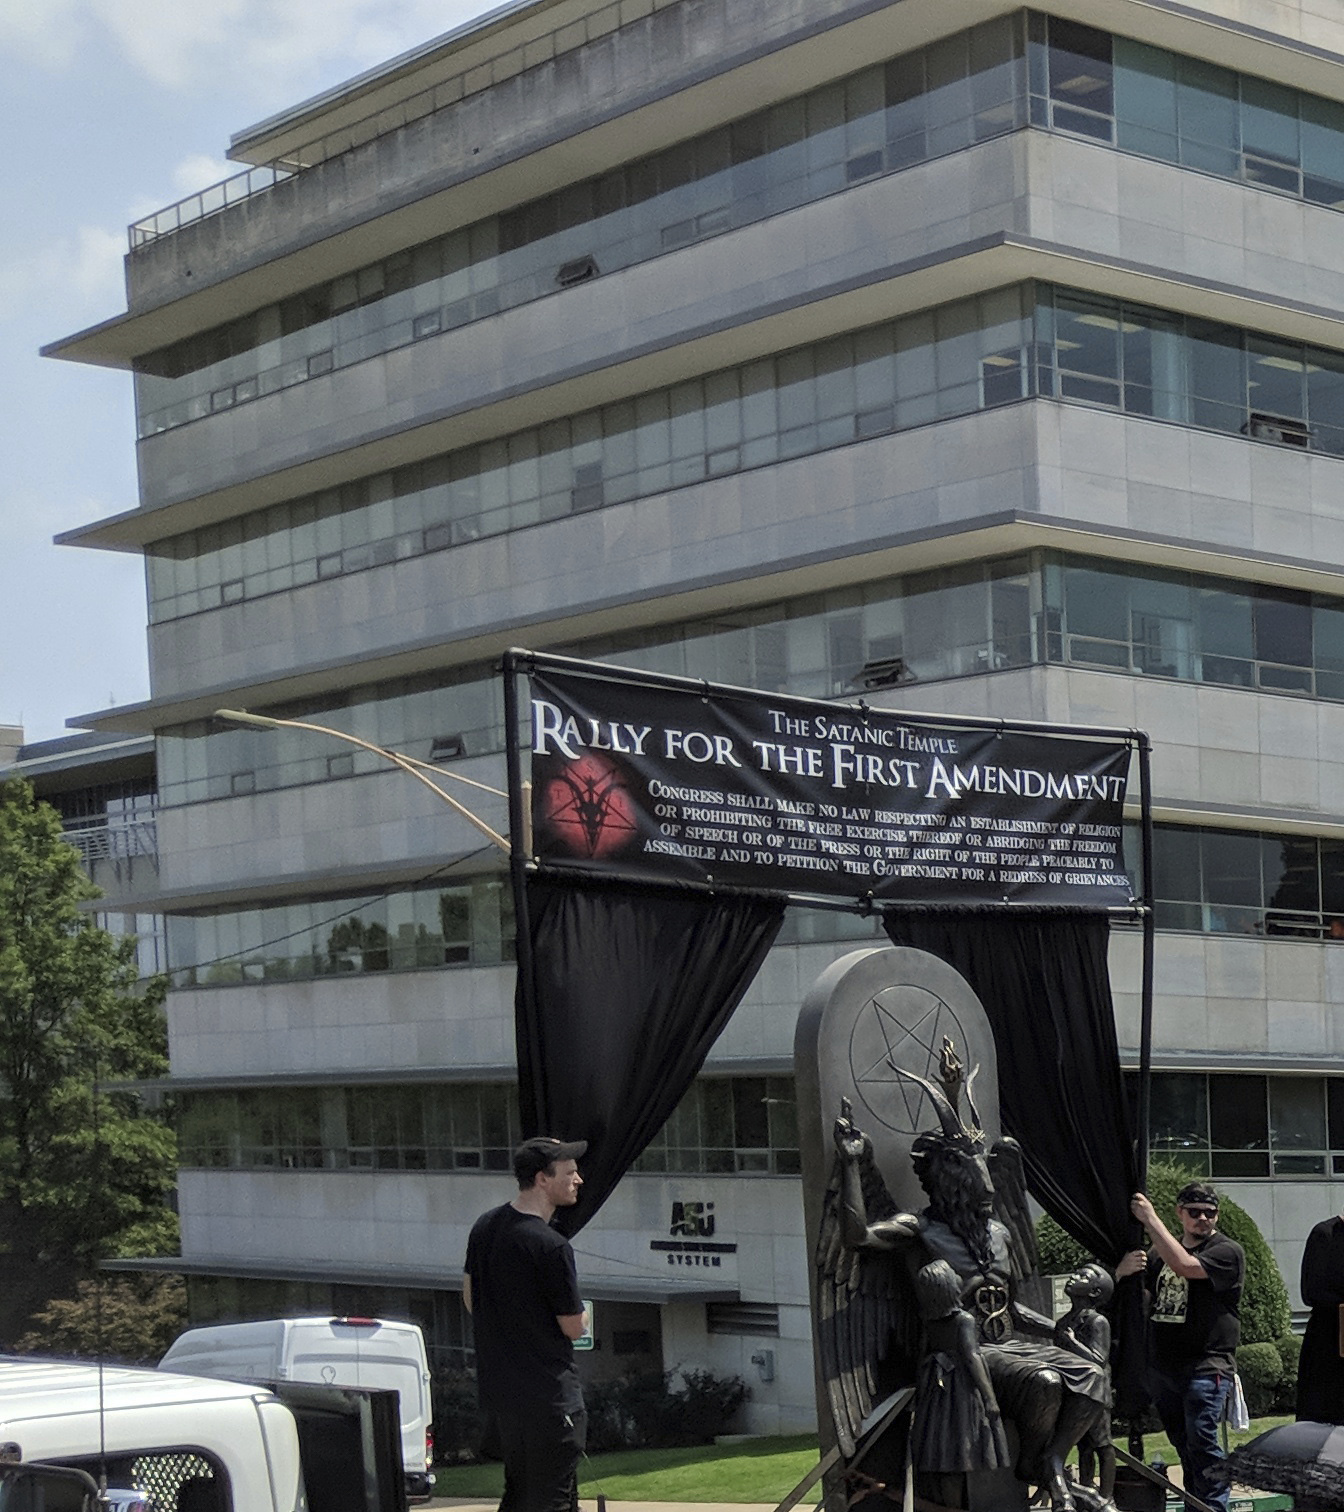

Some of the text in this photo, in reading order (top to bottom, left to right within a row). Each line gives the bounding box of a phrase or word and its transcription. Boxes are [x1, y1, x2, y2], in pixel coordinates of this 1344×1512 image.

[531, 699, 1126, 802] RALLY FOR THE FIRST AMENDMENT
[768, 709, 958, 755] THE SATANIC TEMPLE
[648, 779, 1122, 838] CONGRESS SHALL MAKE NO LAW RESPECTING AN ESTABLISHMENT OF RELIGION
[655, 803, 1117, 854] OR PROHIBITING THE FREE EXERCISE THEREOF OR ABRIDGING THE FREEDOM
[643, 838, 1130, 887] ASSEMBLE AND TO PETITION THE GOVERNMENT FOR A REDRESS OF GRIEVANCES
[660, 822, 1115, 870] OF SPEECH OR OF THE PRESS OR THE RIGHT OF THE PEOPLE PEACEABLY TO
[667, 1253, 721, 1267] SYSTEM
